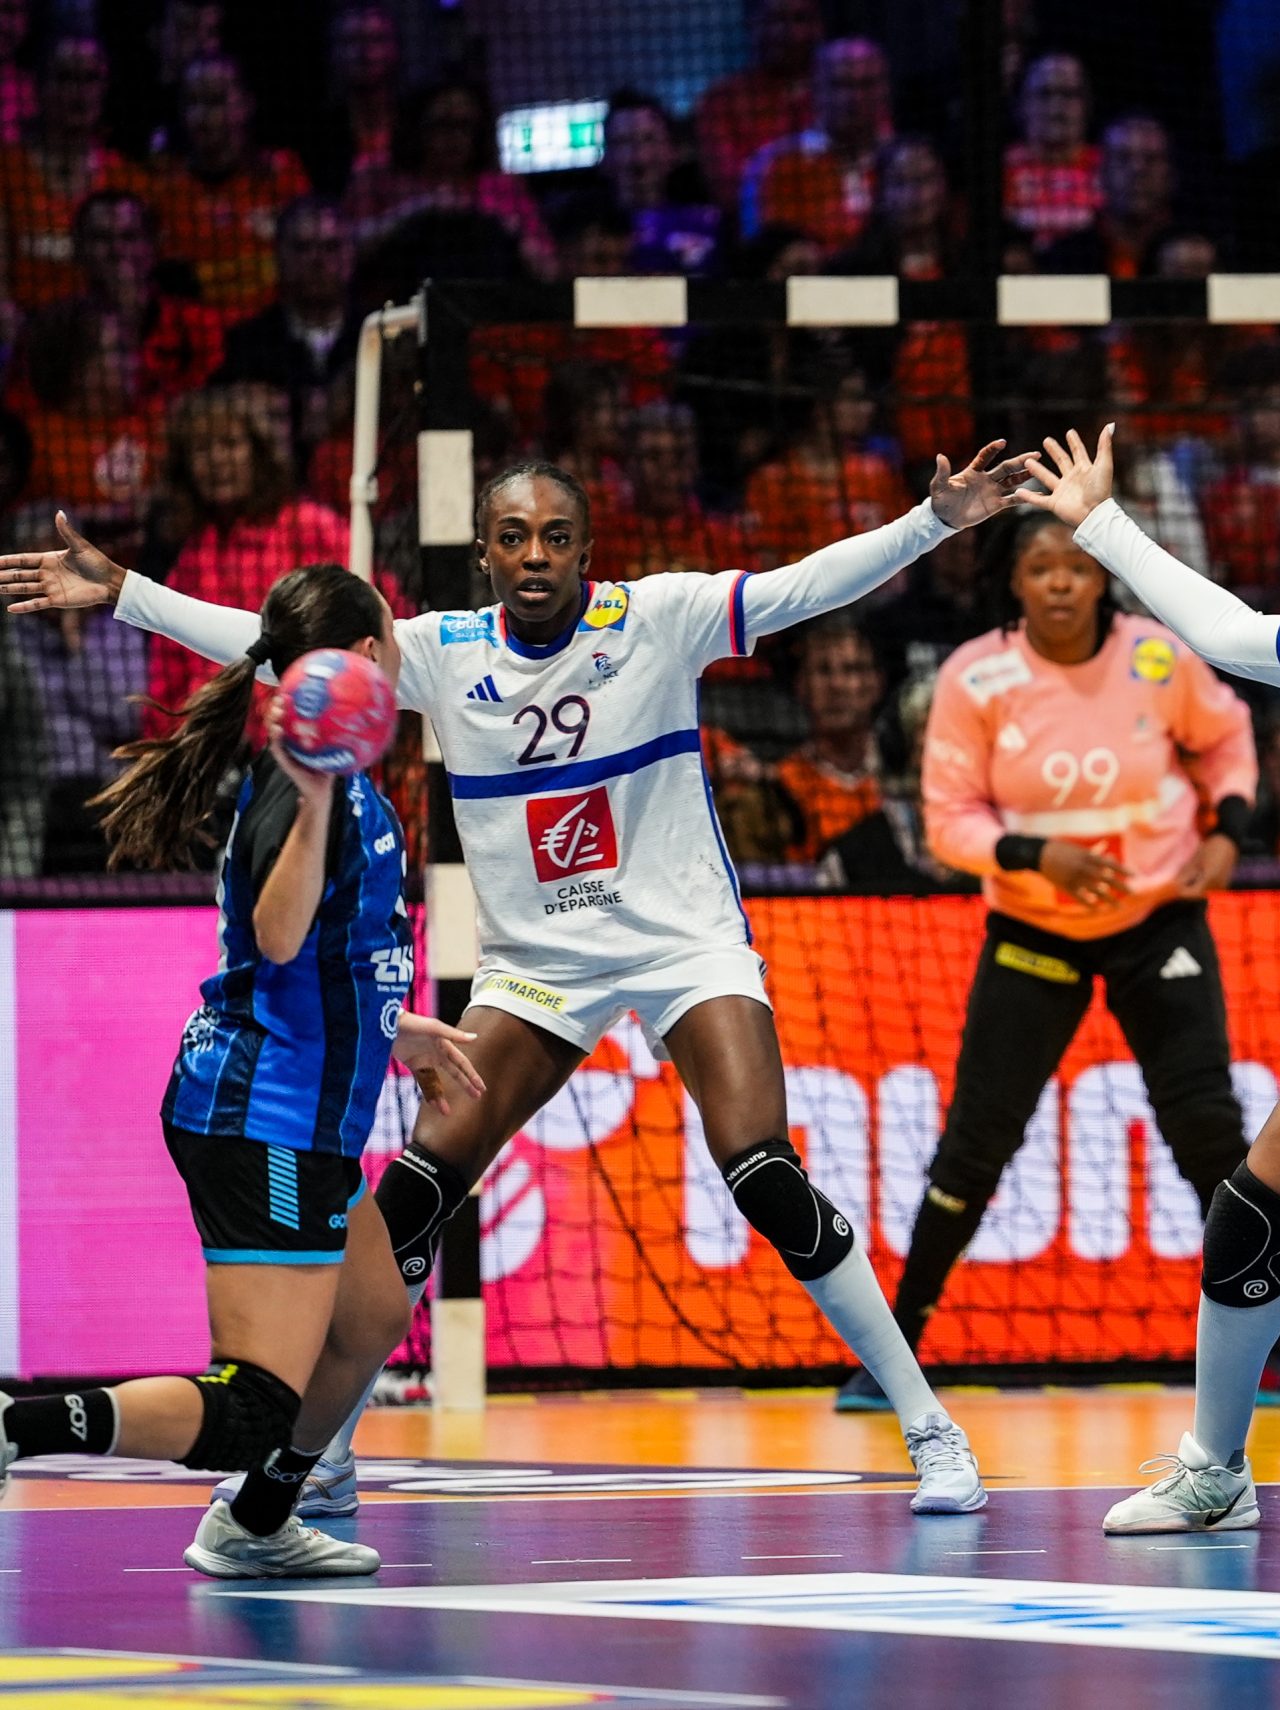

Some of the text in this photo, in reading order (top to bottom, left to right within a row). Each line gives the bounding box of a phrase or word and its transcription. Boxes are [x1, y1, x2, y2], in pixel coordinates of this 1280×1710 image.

[513, 694, 590, 766] 29
[1041, 748, 1119, 807] 99
[544, 891, 623, 915] D'EPARGNE
[557, 880, 605, 899] CAISSE
[63, 1393, 88, 1441] GO7
